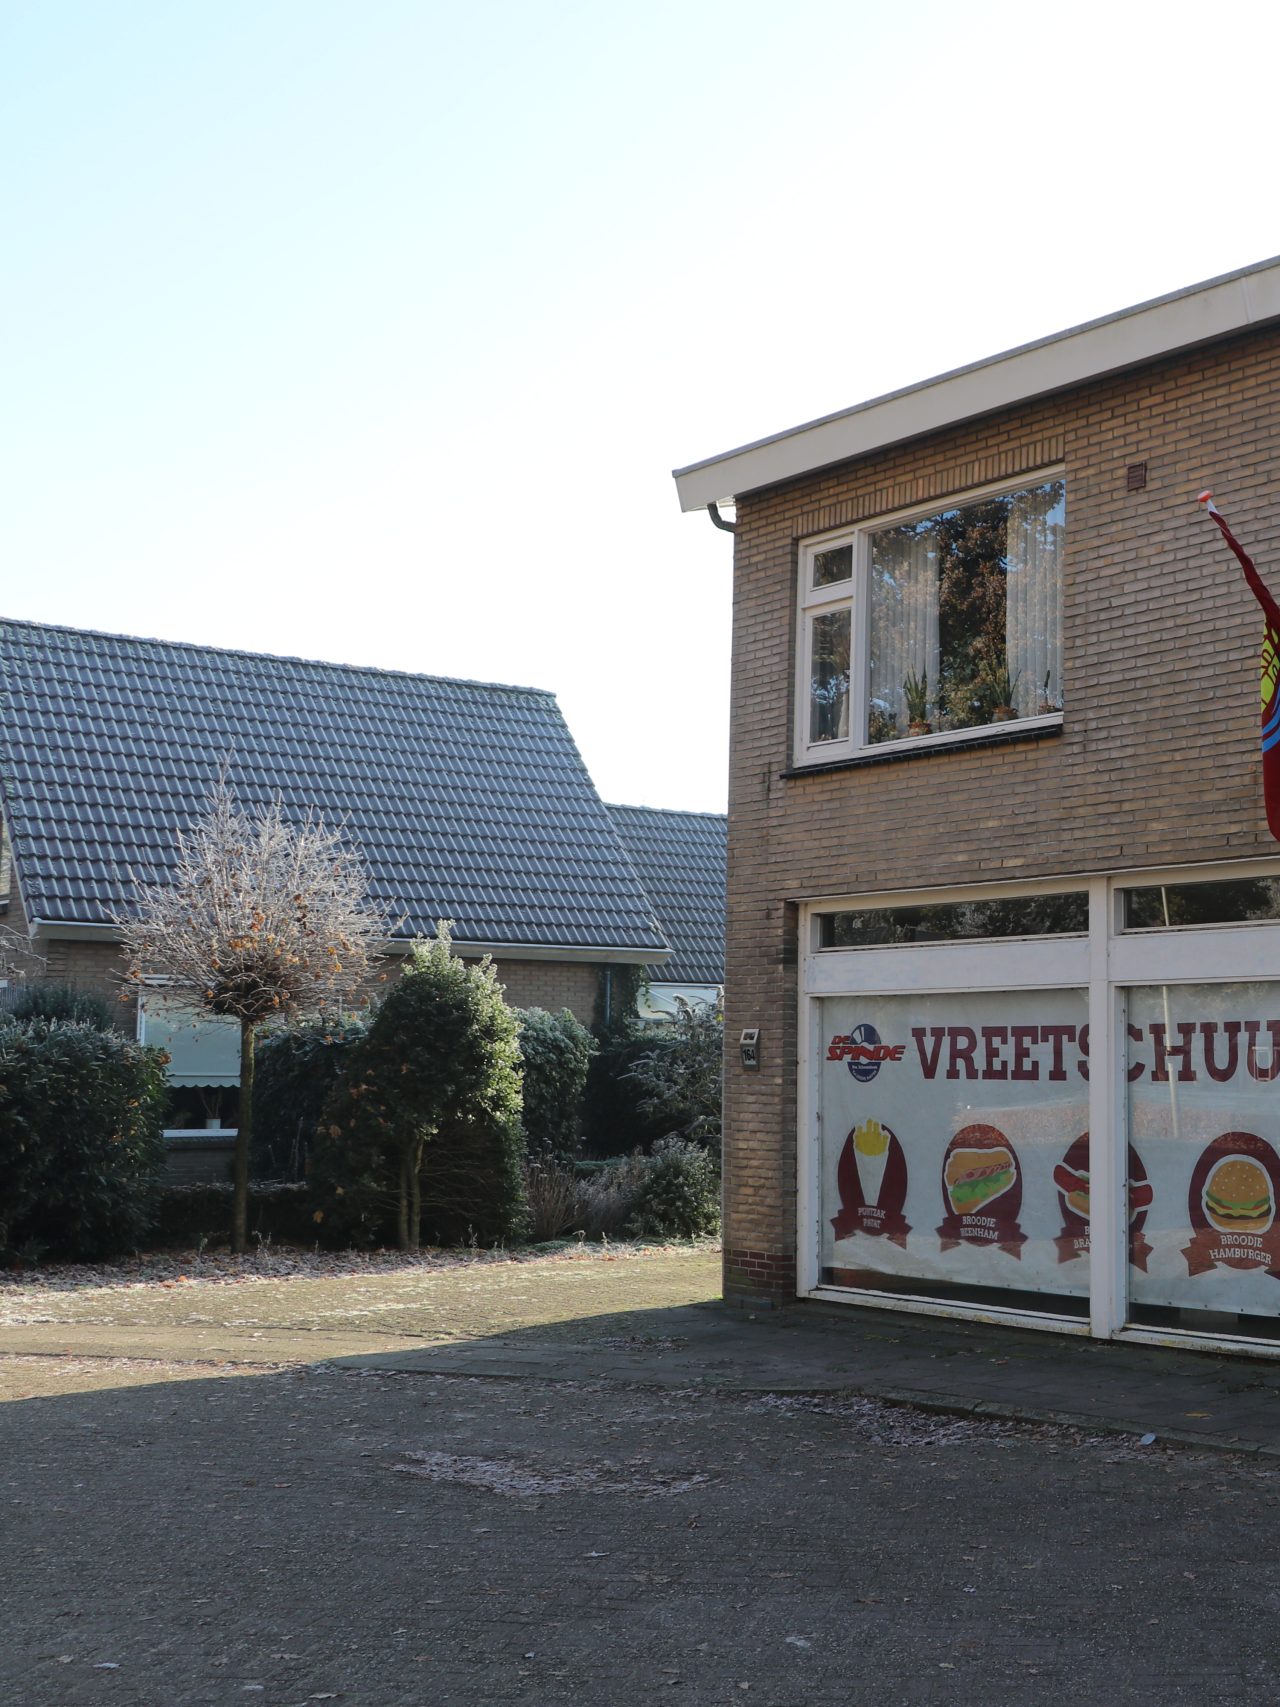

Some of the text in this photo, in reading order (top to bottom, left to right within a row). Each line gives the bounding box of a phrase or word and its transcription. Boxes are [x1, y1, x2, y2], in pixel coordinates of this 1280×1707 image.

[831, 1035, 852, 1045] DE
[826, 1045, 906, 1061] SPINDE
[962, 1215, 997, 1228] BROODJE
[959, 1227, 999, 1241] BEENHAM
[1220, 1234, 1263, 1248] BROODJE
[1208, 1248, 1272, 1265] HAMBURGER
